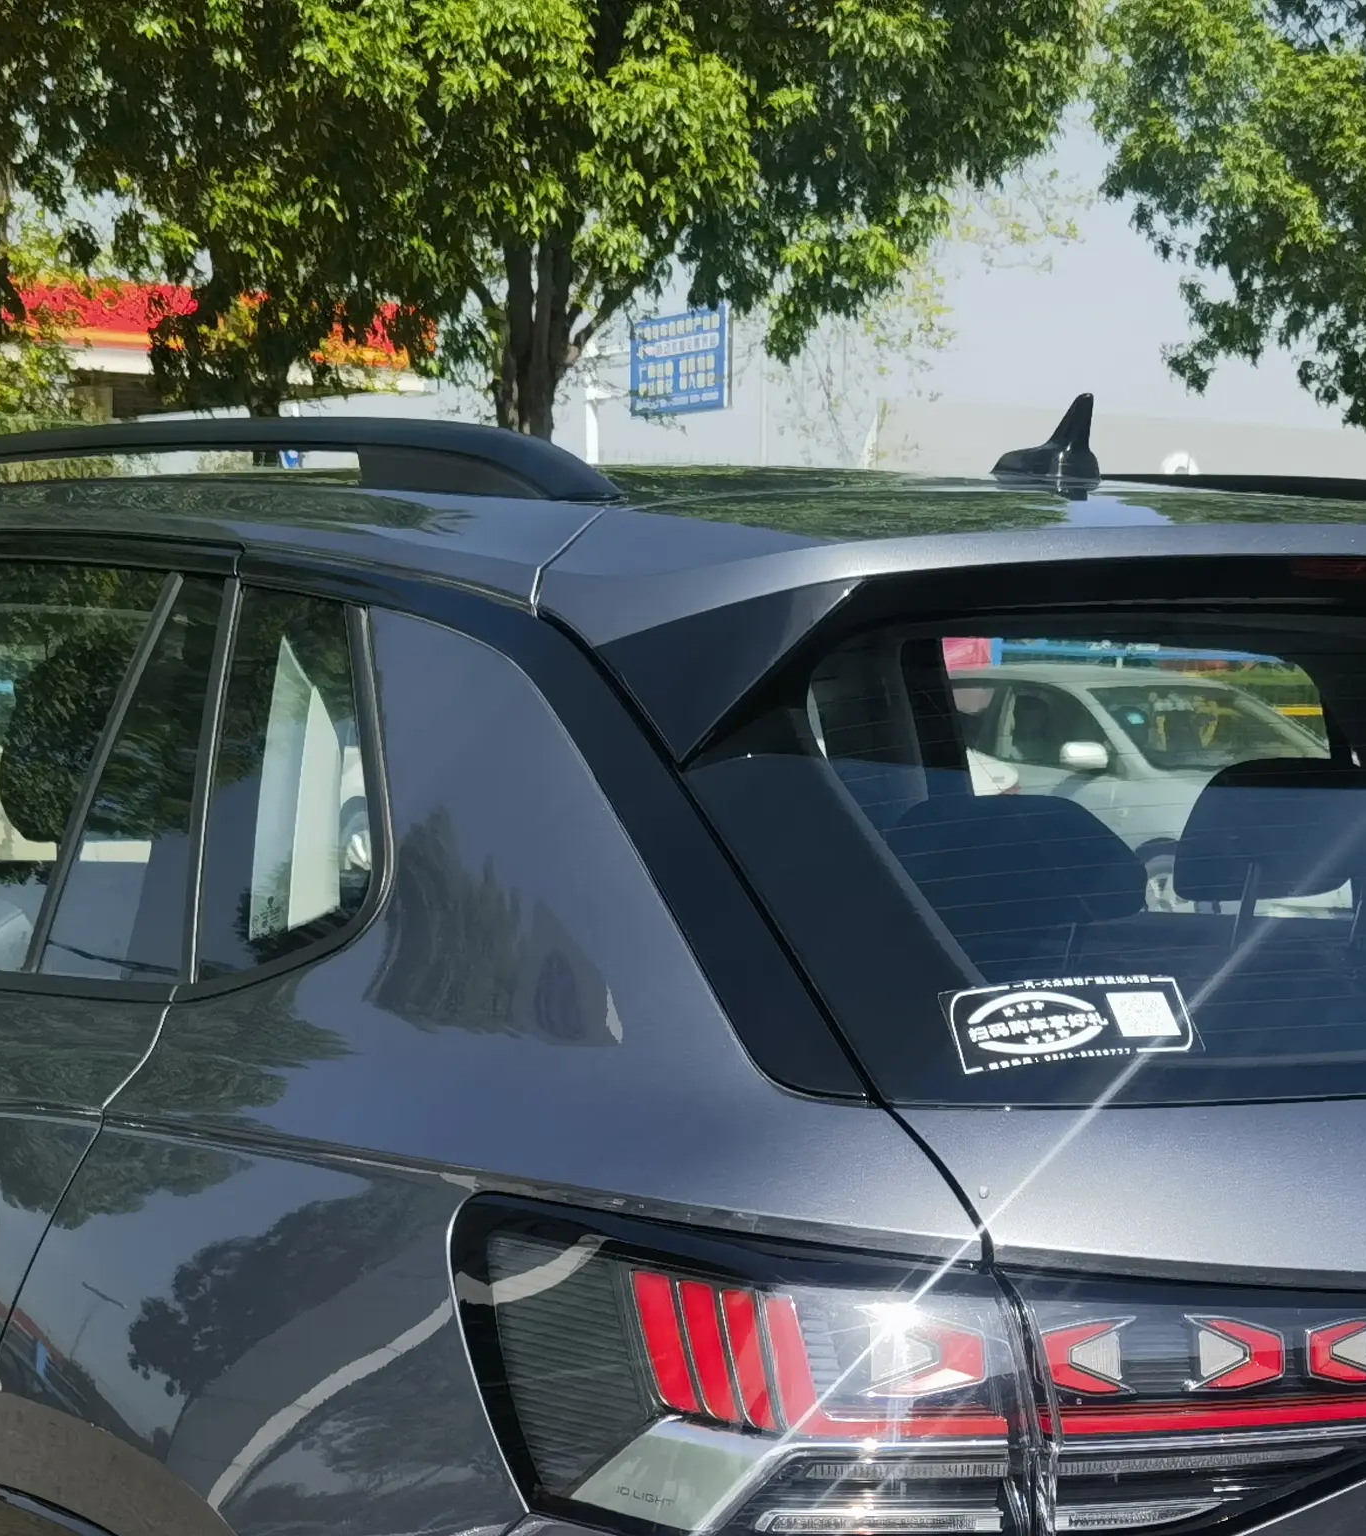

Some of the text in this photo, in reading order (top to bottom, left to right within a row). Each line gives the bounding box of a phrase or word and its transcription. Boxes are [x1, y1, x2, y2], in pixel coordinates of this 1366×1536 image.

[968, 1012, 1109, 1043] 扫码购车享好礼
